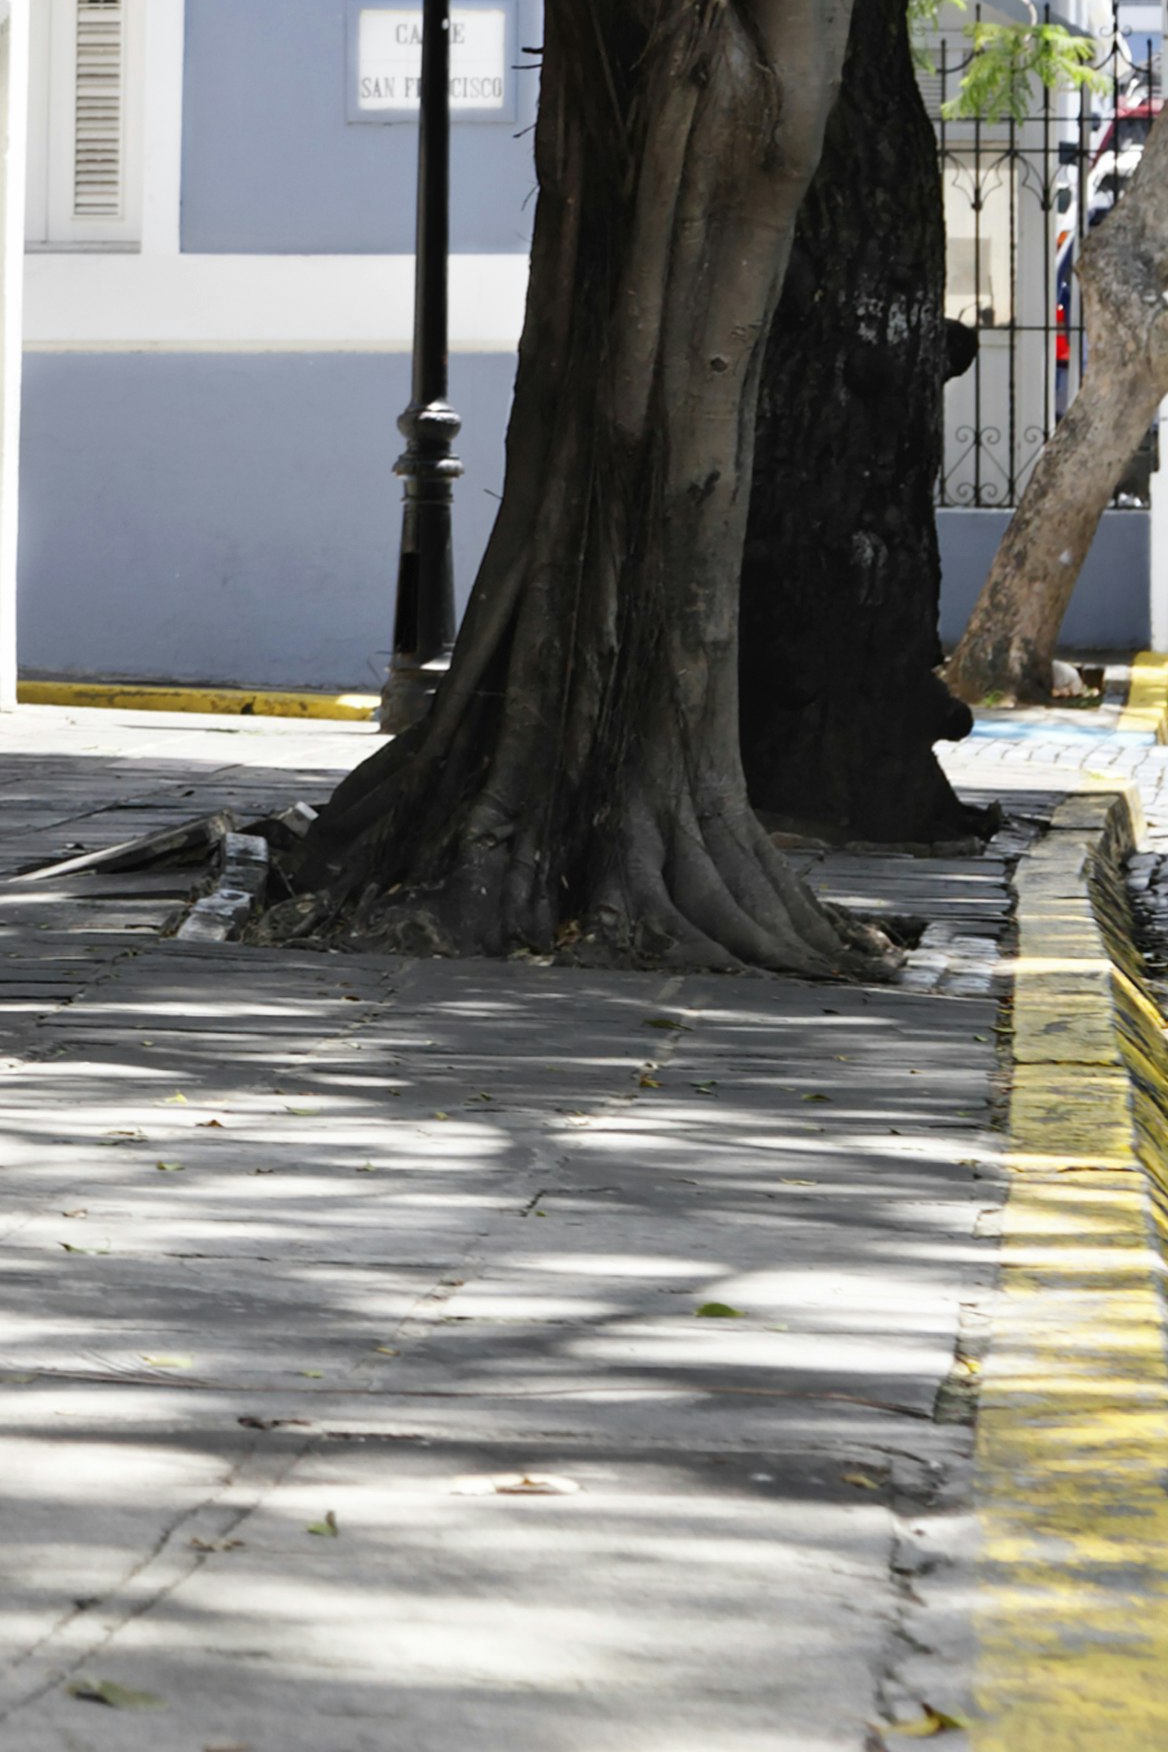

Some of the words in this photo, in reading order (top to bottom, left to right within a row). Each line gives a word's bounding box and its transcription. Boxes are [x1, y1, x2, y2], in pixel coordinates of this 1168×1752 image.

[395, 23, 465, 44] CAE
[361, 77, 395, 98] SAN
[404, 77, 503, 98] FCISCO
